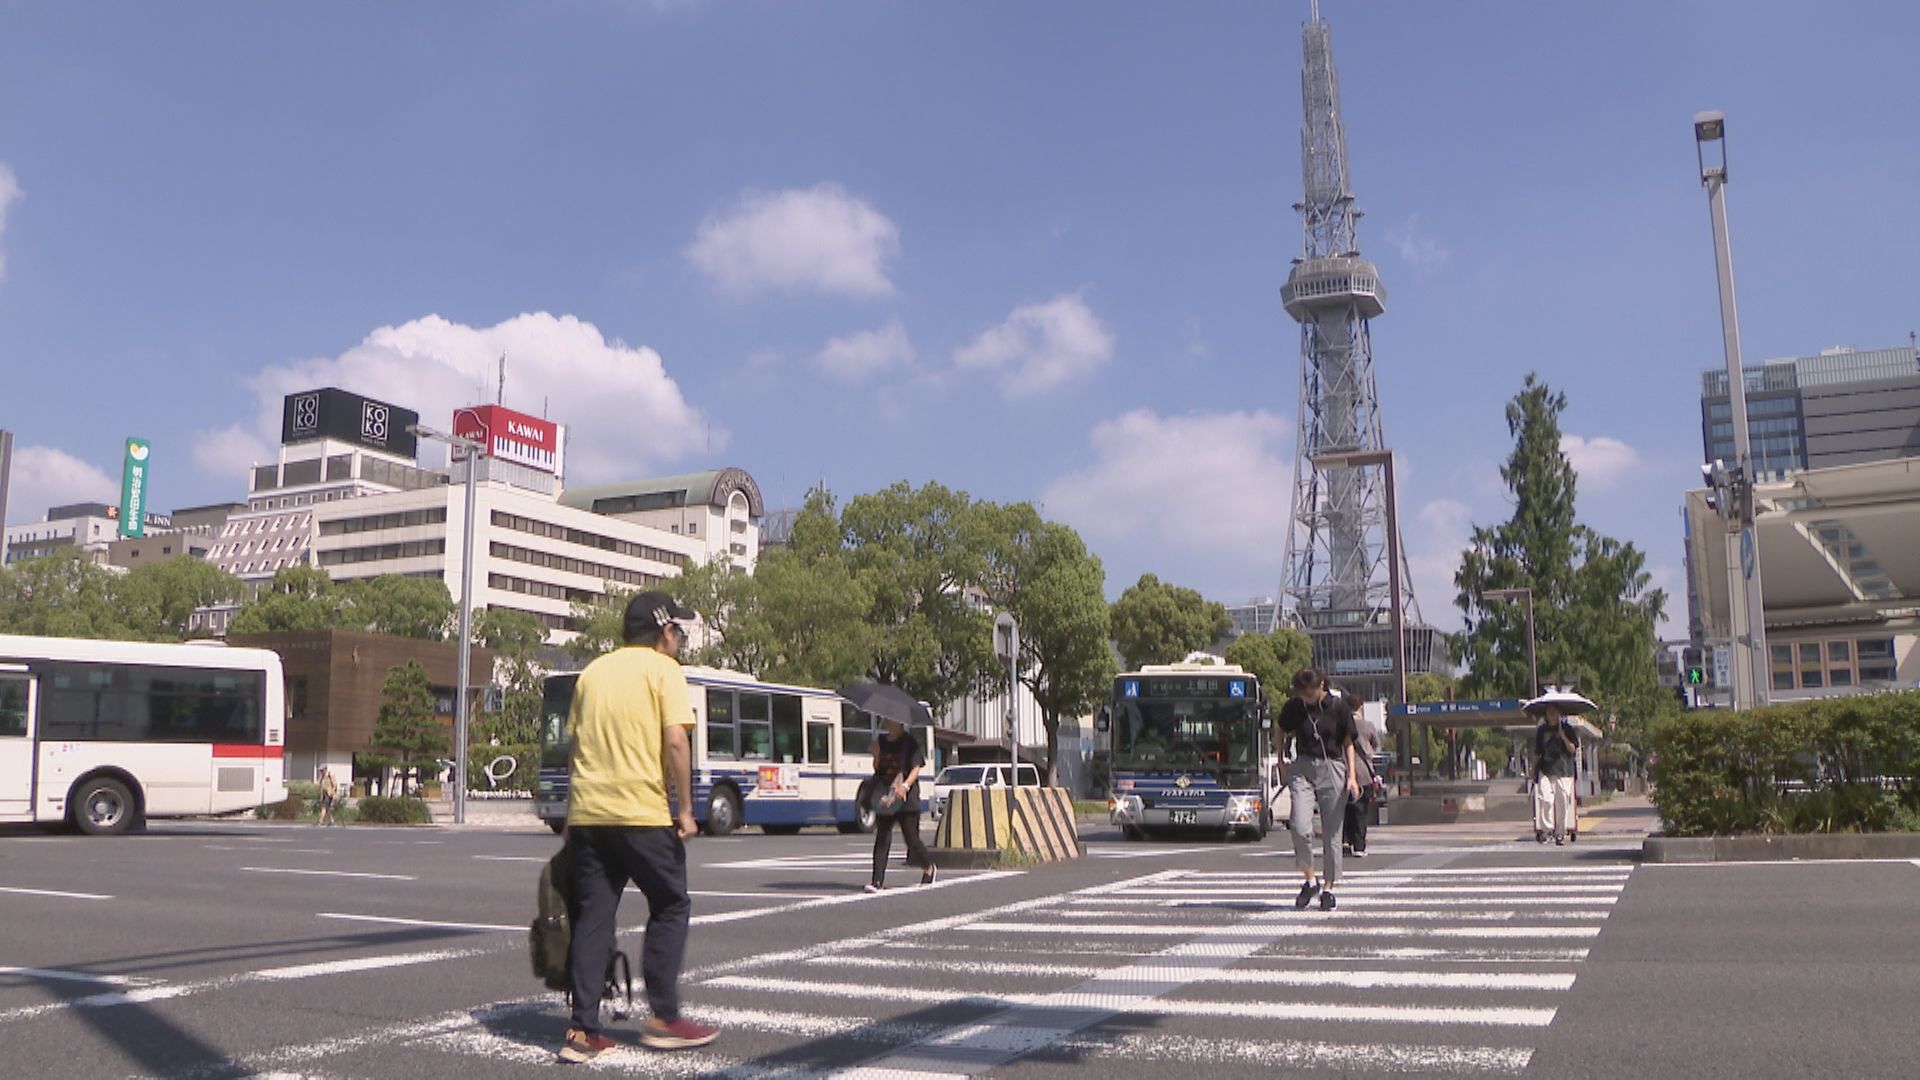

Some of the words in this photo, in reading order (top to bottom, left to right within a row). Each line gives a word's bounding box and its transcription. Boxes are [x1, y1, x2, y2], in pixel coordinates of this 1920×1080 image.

[458, 429, 483, 440] KAWAI
[507, 420, 544, 443] KAWAI
[154, 515, 170, 526] INN
